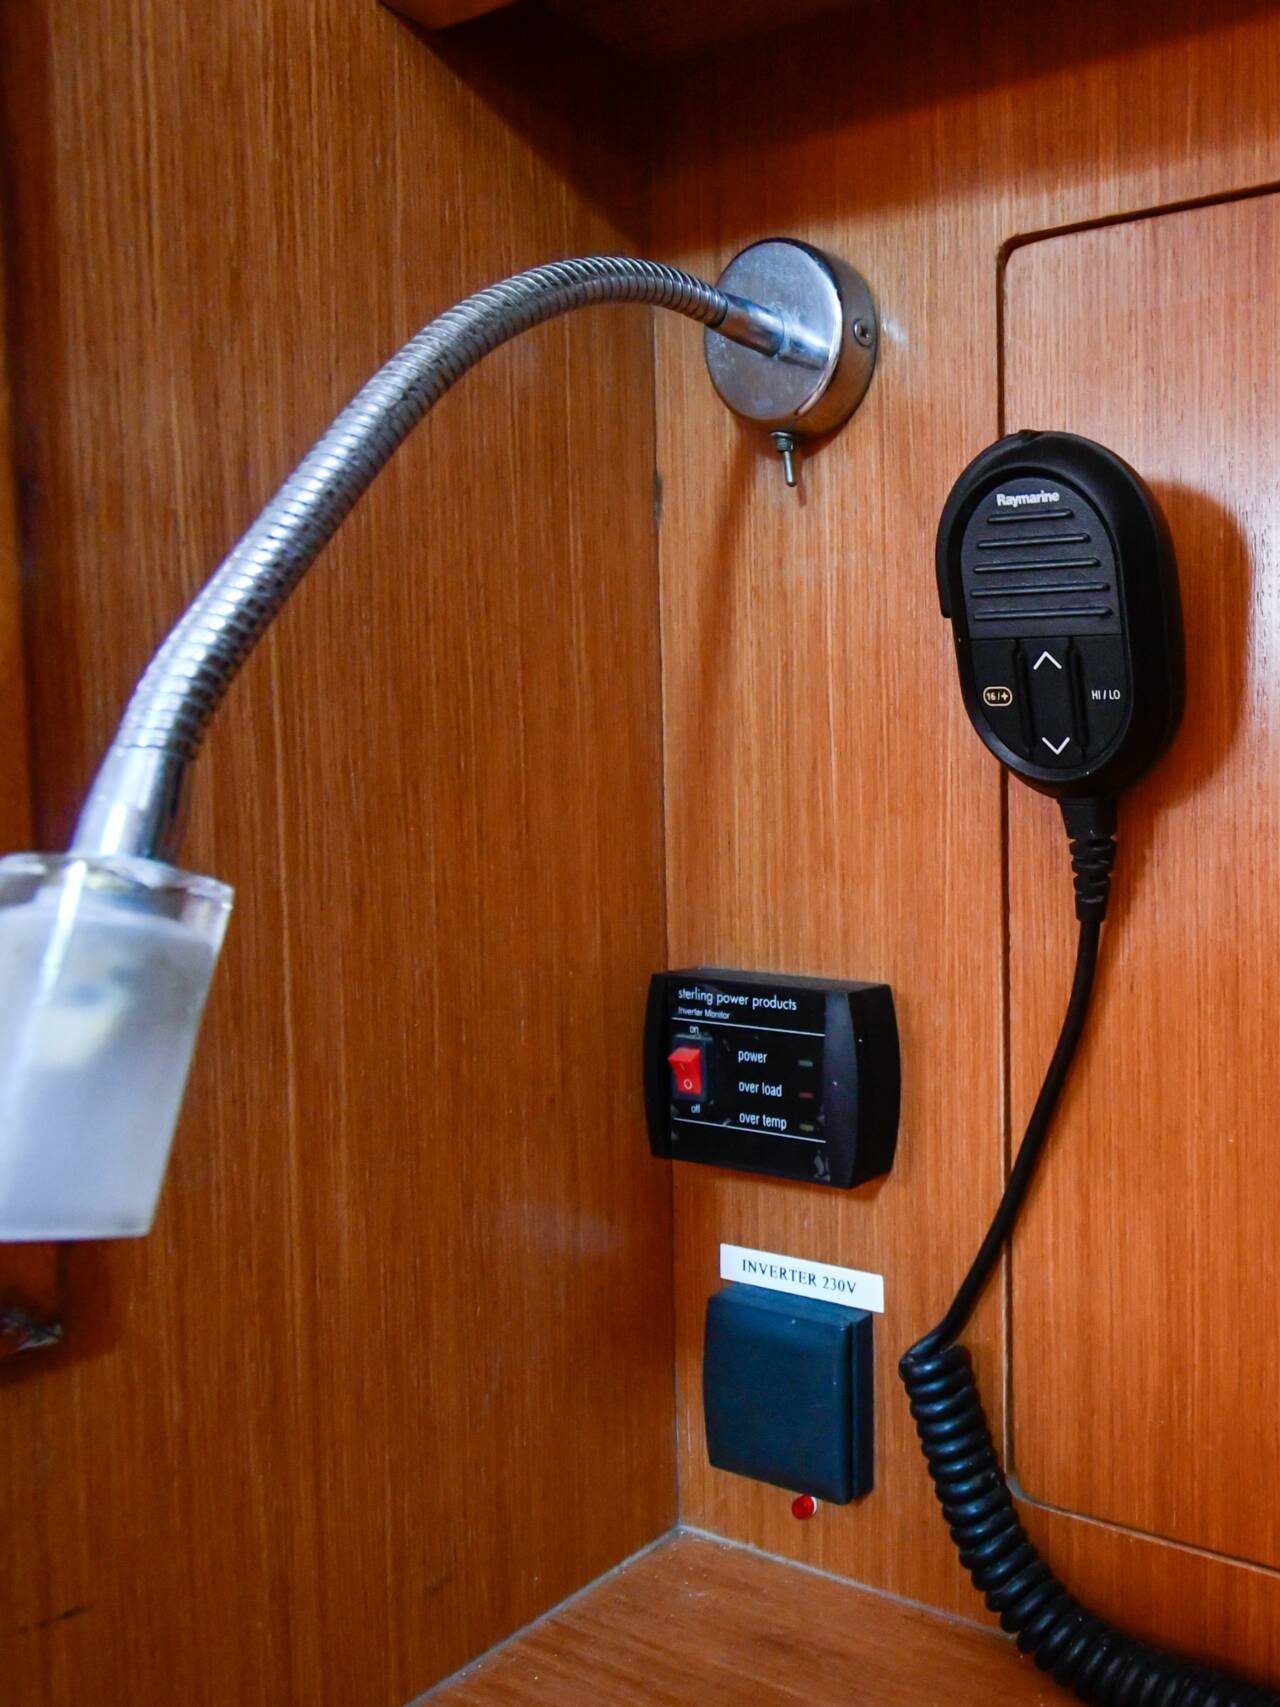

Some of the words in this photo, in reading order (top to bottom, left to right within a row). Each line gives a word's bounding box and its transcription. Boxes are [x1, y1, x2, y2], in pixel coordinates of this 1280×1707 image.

[996, 489, 1060, 508] Raymarine
[678, 986, 713, 1006] sterling
[716, 993, 750, 1007] power
[751, 995, 798, 1011] products
[678, 1006, 704, 1017] Inverter
[704, 1008, 731, 1020] Monitor
[689, 1025, 700, 1034] on
[738, 1050, 768, 1064] power
[738, 1081, 760, 1094] over
[761, 1081, 783, 1098] load
[739, 1112, 761, 1126] over
[762, 1114, 788, 1131] temp
[742, 1258, 818, 1287] INVERTER
[822, 1276, 857, 1295] 230V
